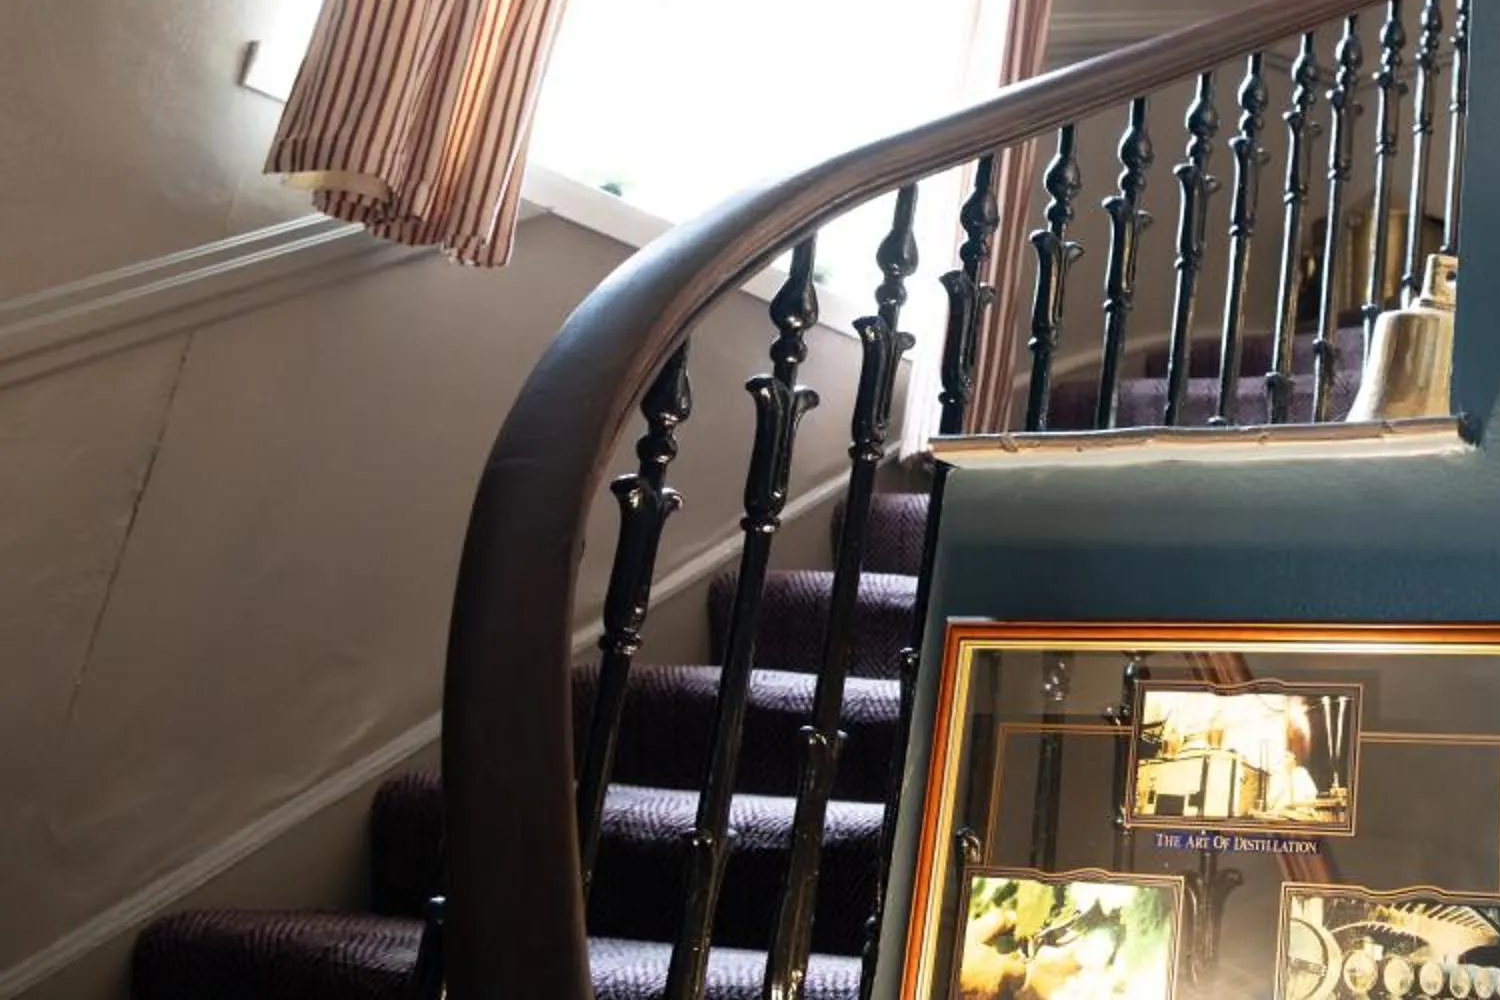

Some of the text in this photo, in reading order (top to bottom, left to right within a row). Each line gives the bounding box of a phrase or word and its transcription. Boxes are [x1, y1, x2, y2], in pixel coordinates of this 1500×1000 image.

[1155, 833, 1181, 849] THE
[1186, 834, 1211, 850] ART
[1233, 836, 1318, 854] DISTILLATION
